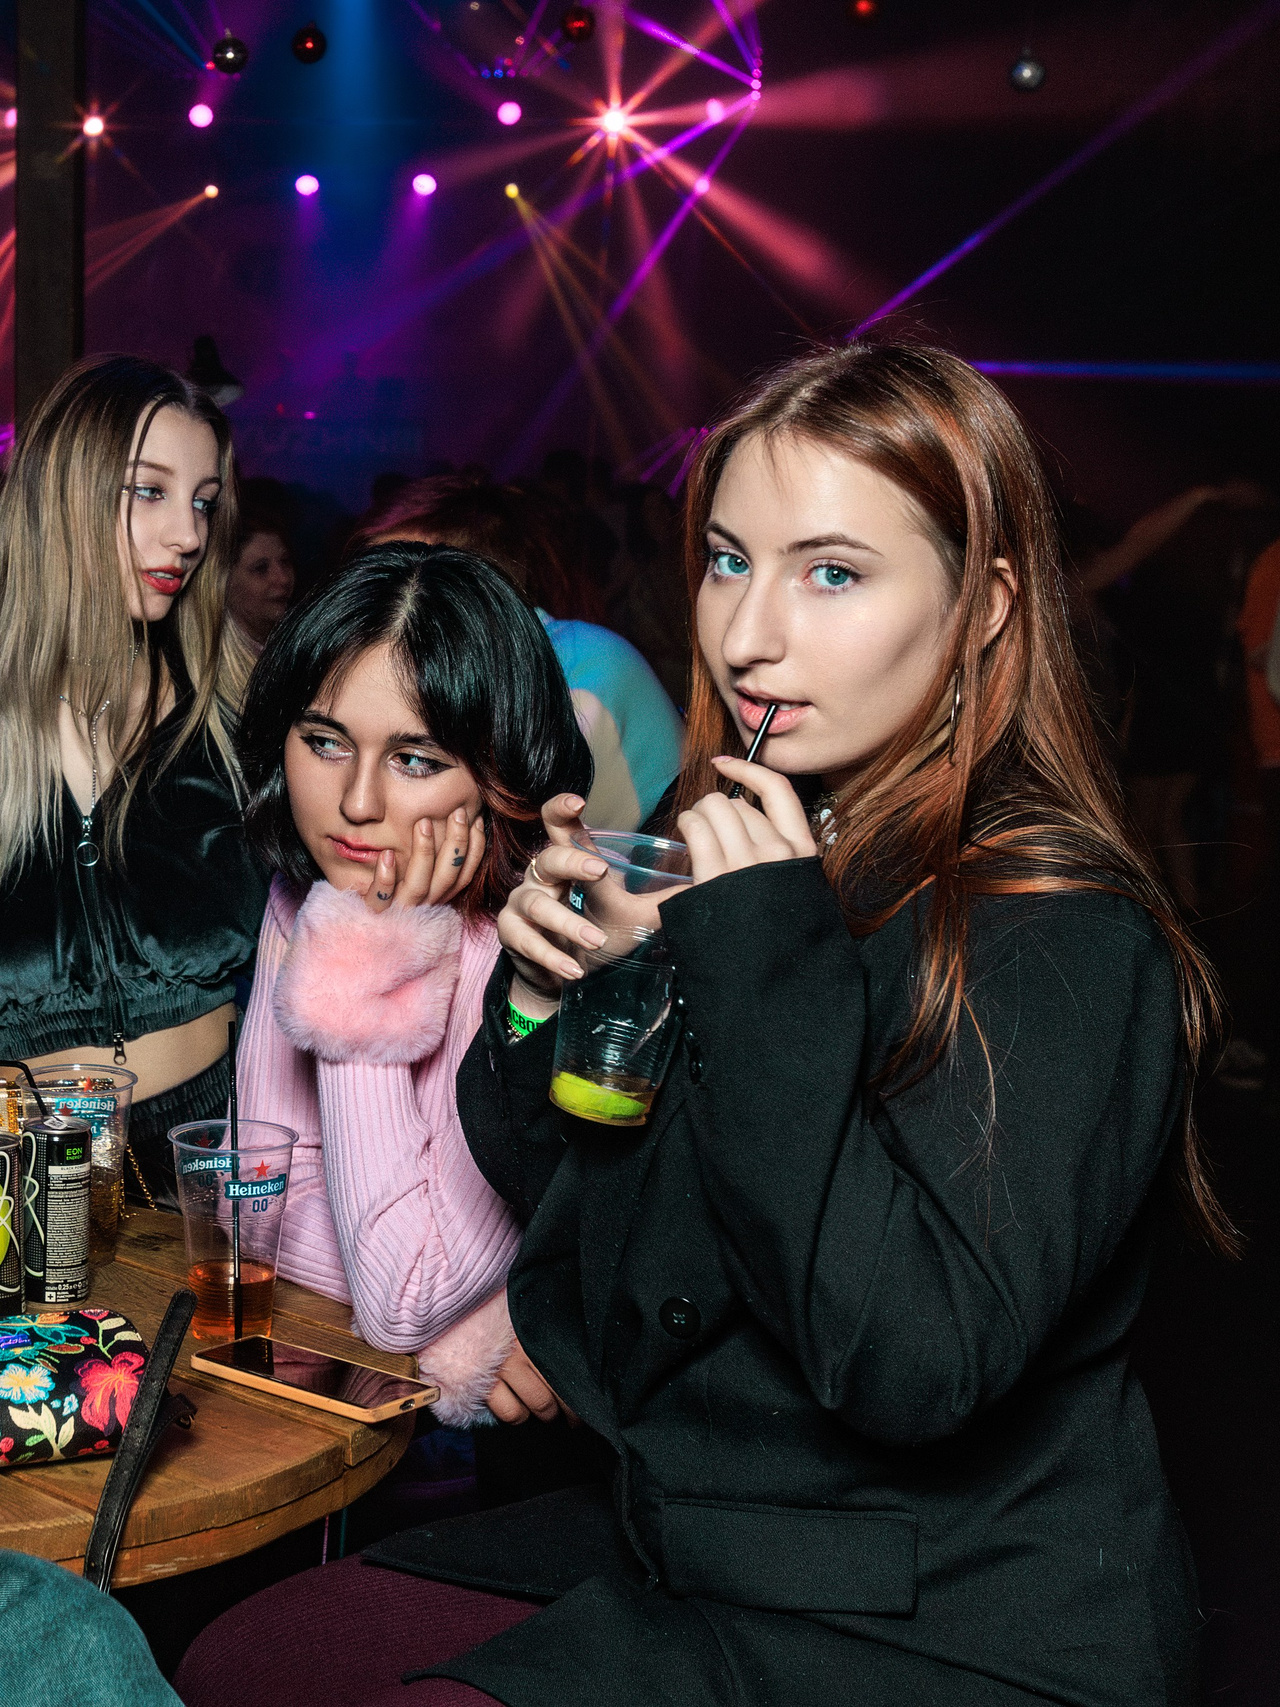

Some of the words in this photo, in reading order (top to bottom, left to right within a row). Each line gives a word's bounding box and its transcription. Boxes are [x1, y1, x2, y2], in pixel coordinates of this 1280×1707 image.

[66, 1147, 83, 1156] EON
[228, 1180, 285, 1197] Heineken
[252, 1198, 269, 1213] 0.0
